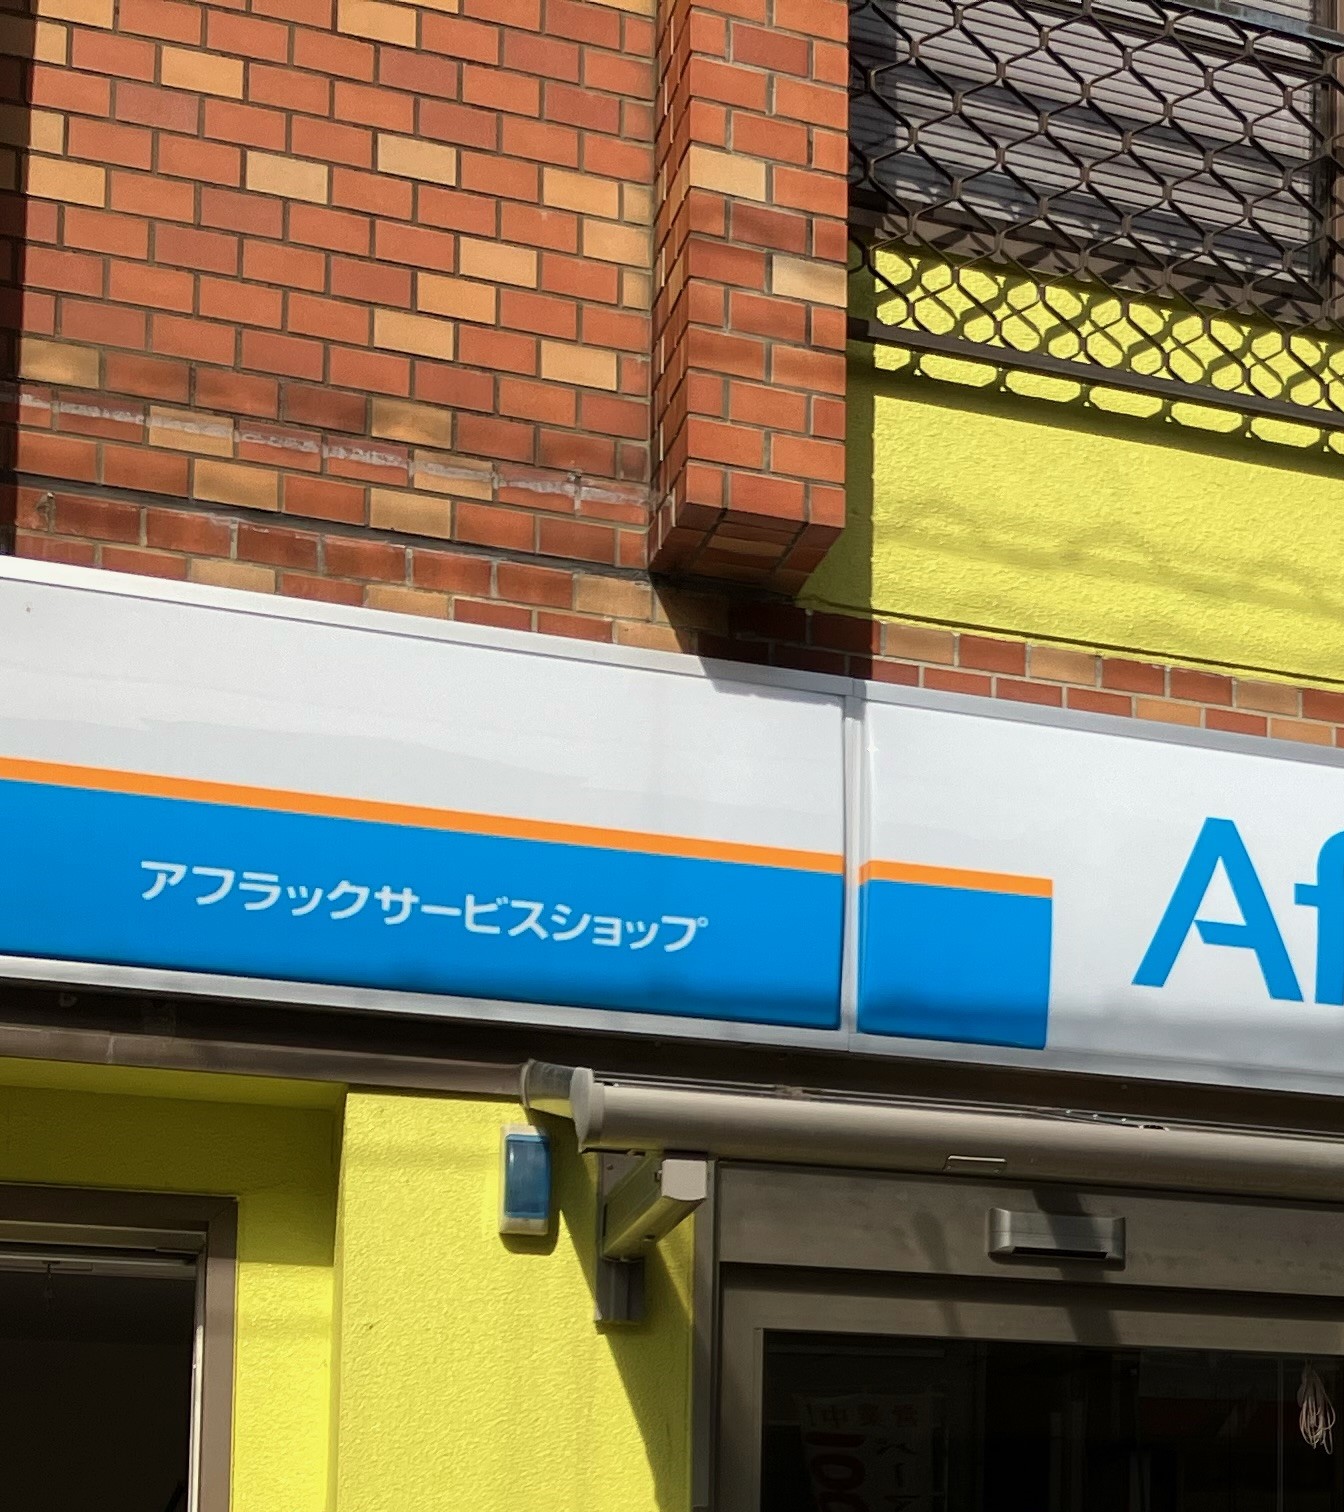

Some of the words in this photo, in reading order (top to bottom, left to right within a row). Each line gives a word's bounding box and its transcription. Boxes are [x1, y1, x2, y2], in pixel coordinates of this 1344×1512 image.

[140, 860, 708, 953] アフラックサービスショップ
